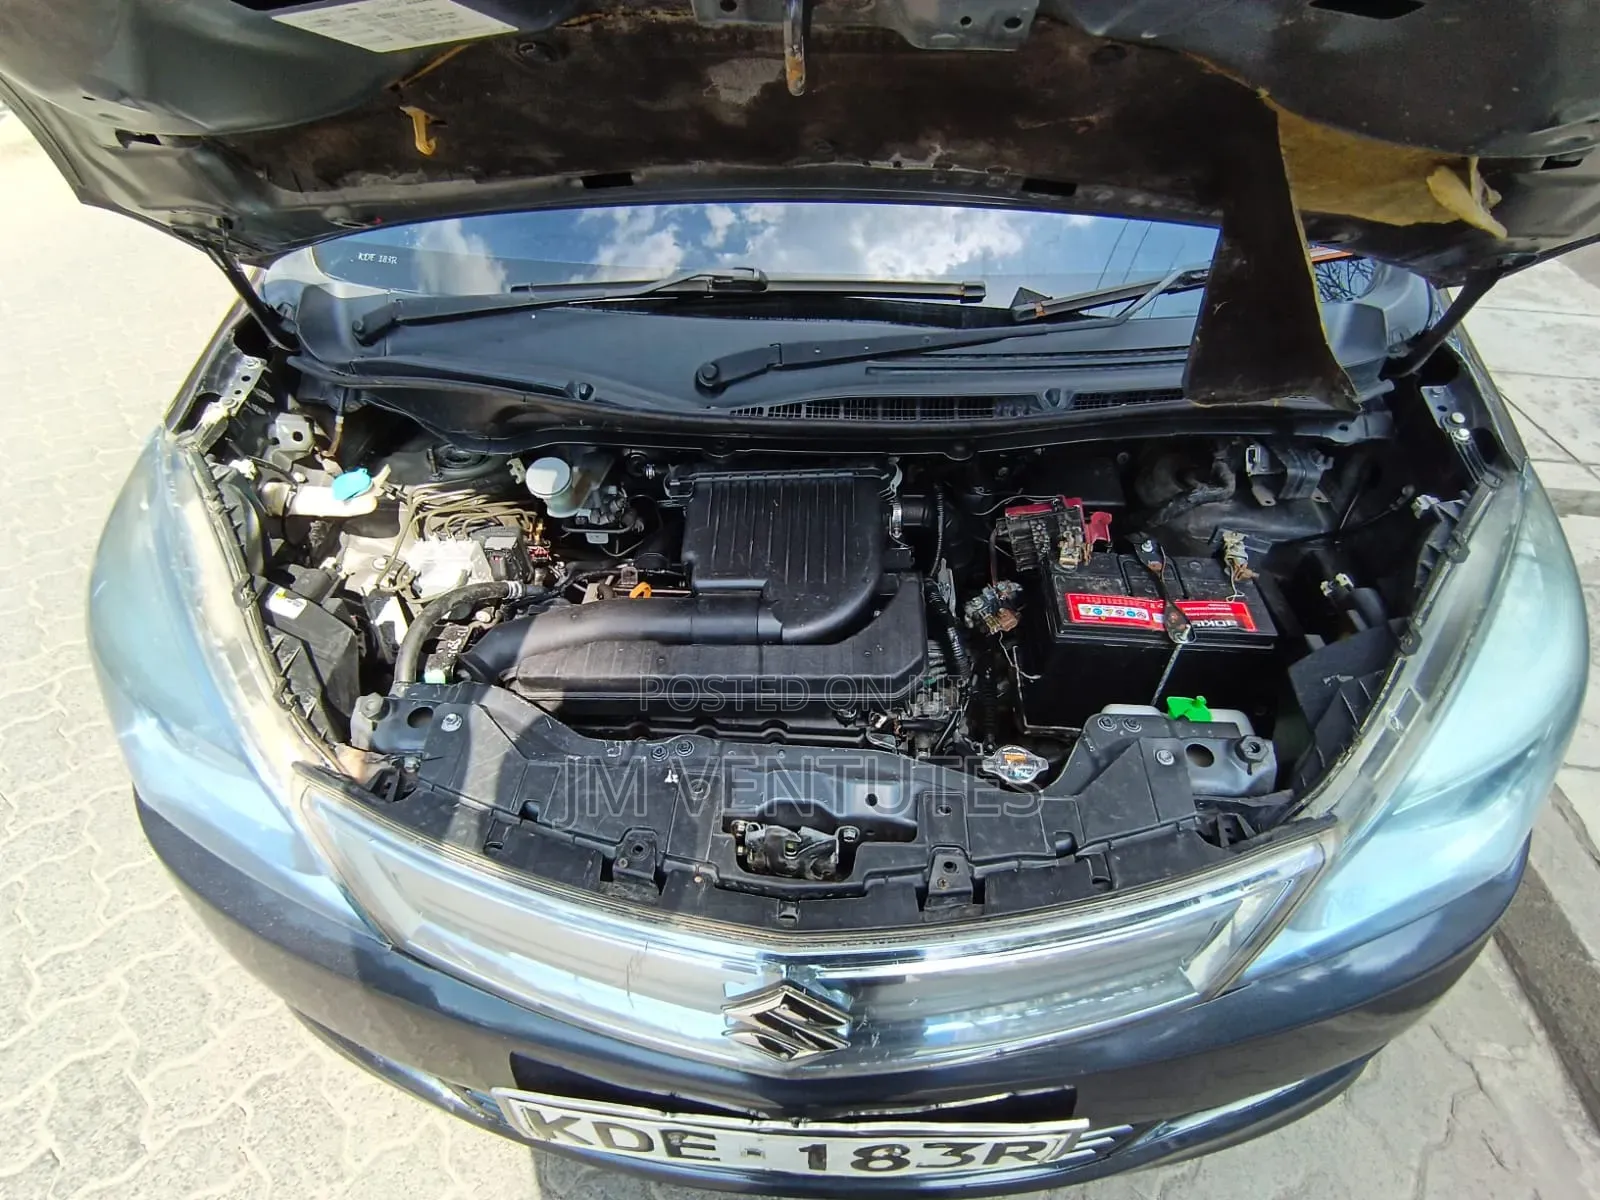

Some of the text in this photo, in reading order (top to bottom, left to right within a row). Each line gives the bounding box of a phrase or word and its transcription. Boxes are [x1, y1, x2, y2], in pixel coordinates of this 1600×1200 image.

[358, 252, 376, 262] KDE
[521, 1108, 1048, 1171] KDE 183R
